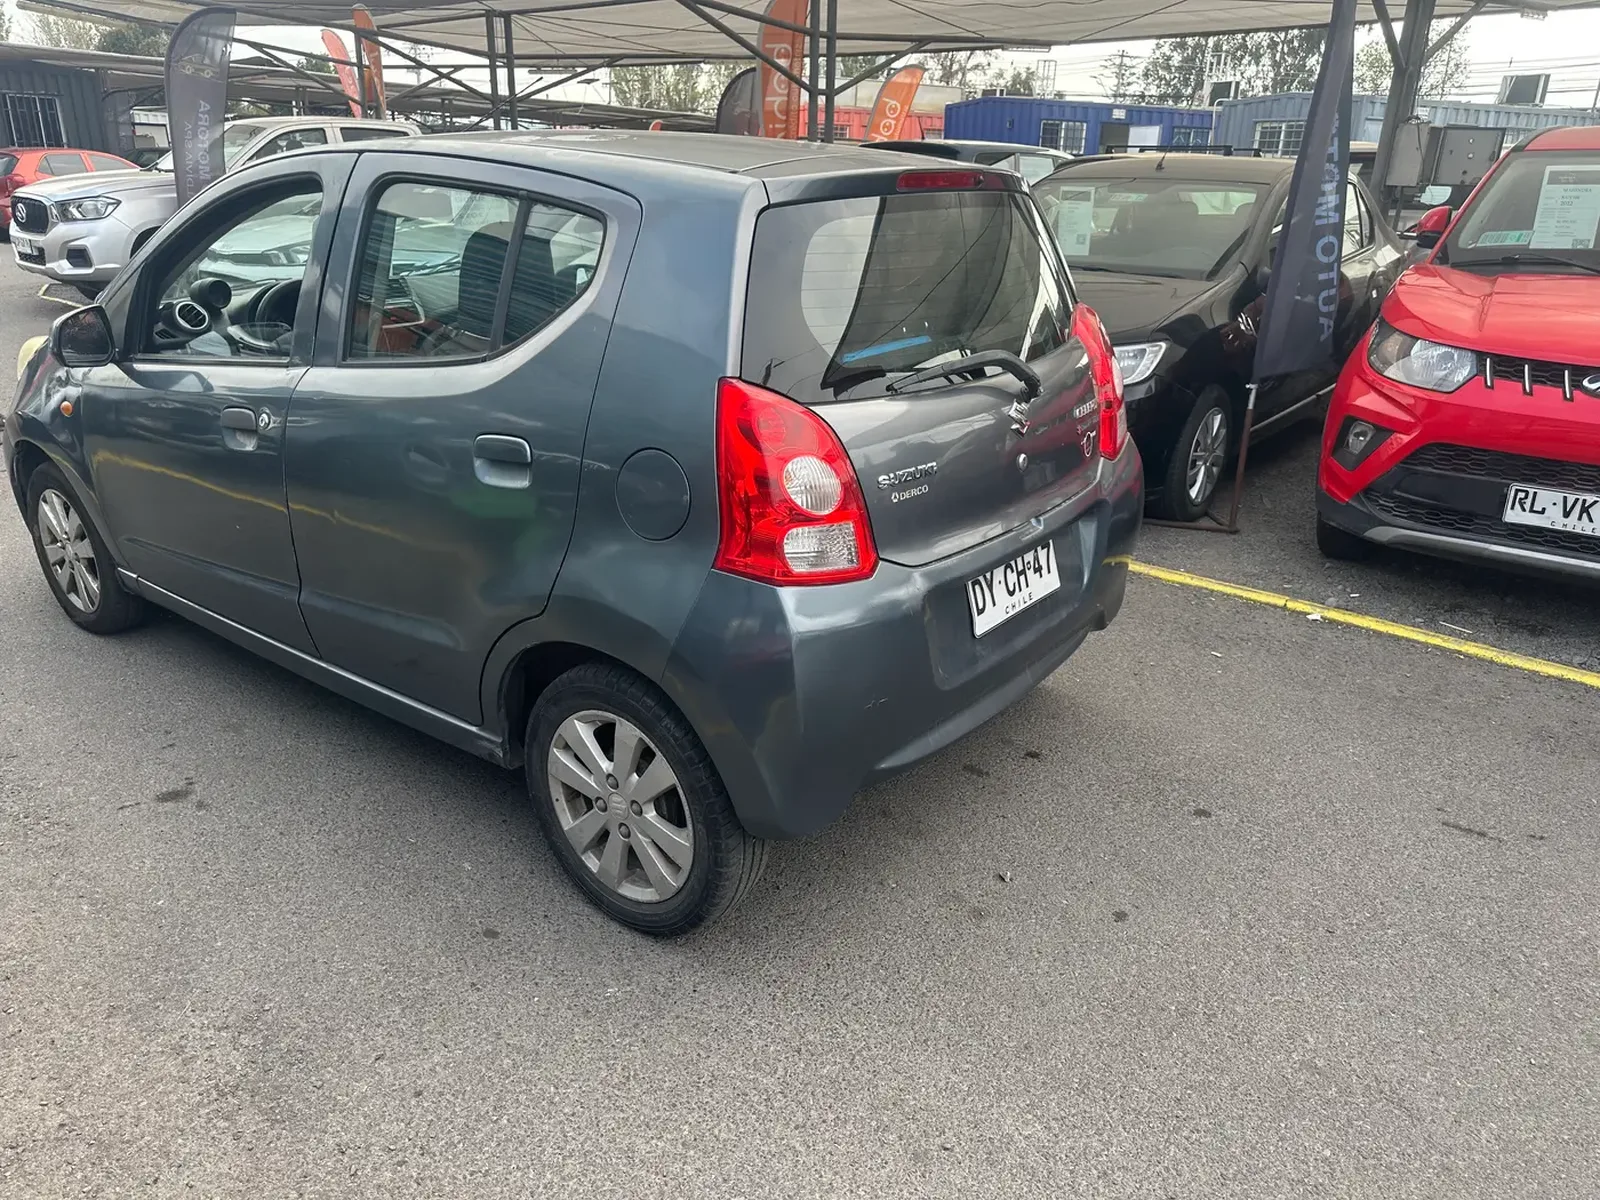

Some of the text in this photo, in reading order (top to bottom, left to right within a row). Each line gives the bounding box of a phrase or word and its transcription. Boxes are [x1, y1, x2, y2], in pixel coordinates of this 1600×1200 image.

[790, 43, 802, 101] autmotriz
[877, 461, 938, 490] SUZUKI
[900, 484, 929, 500] DERCO
[1550, 521, 1598, 534] CHILE
[1004, 592, 1034, 614] CHILE
